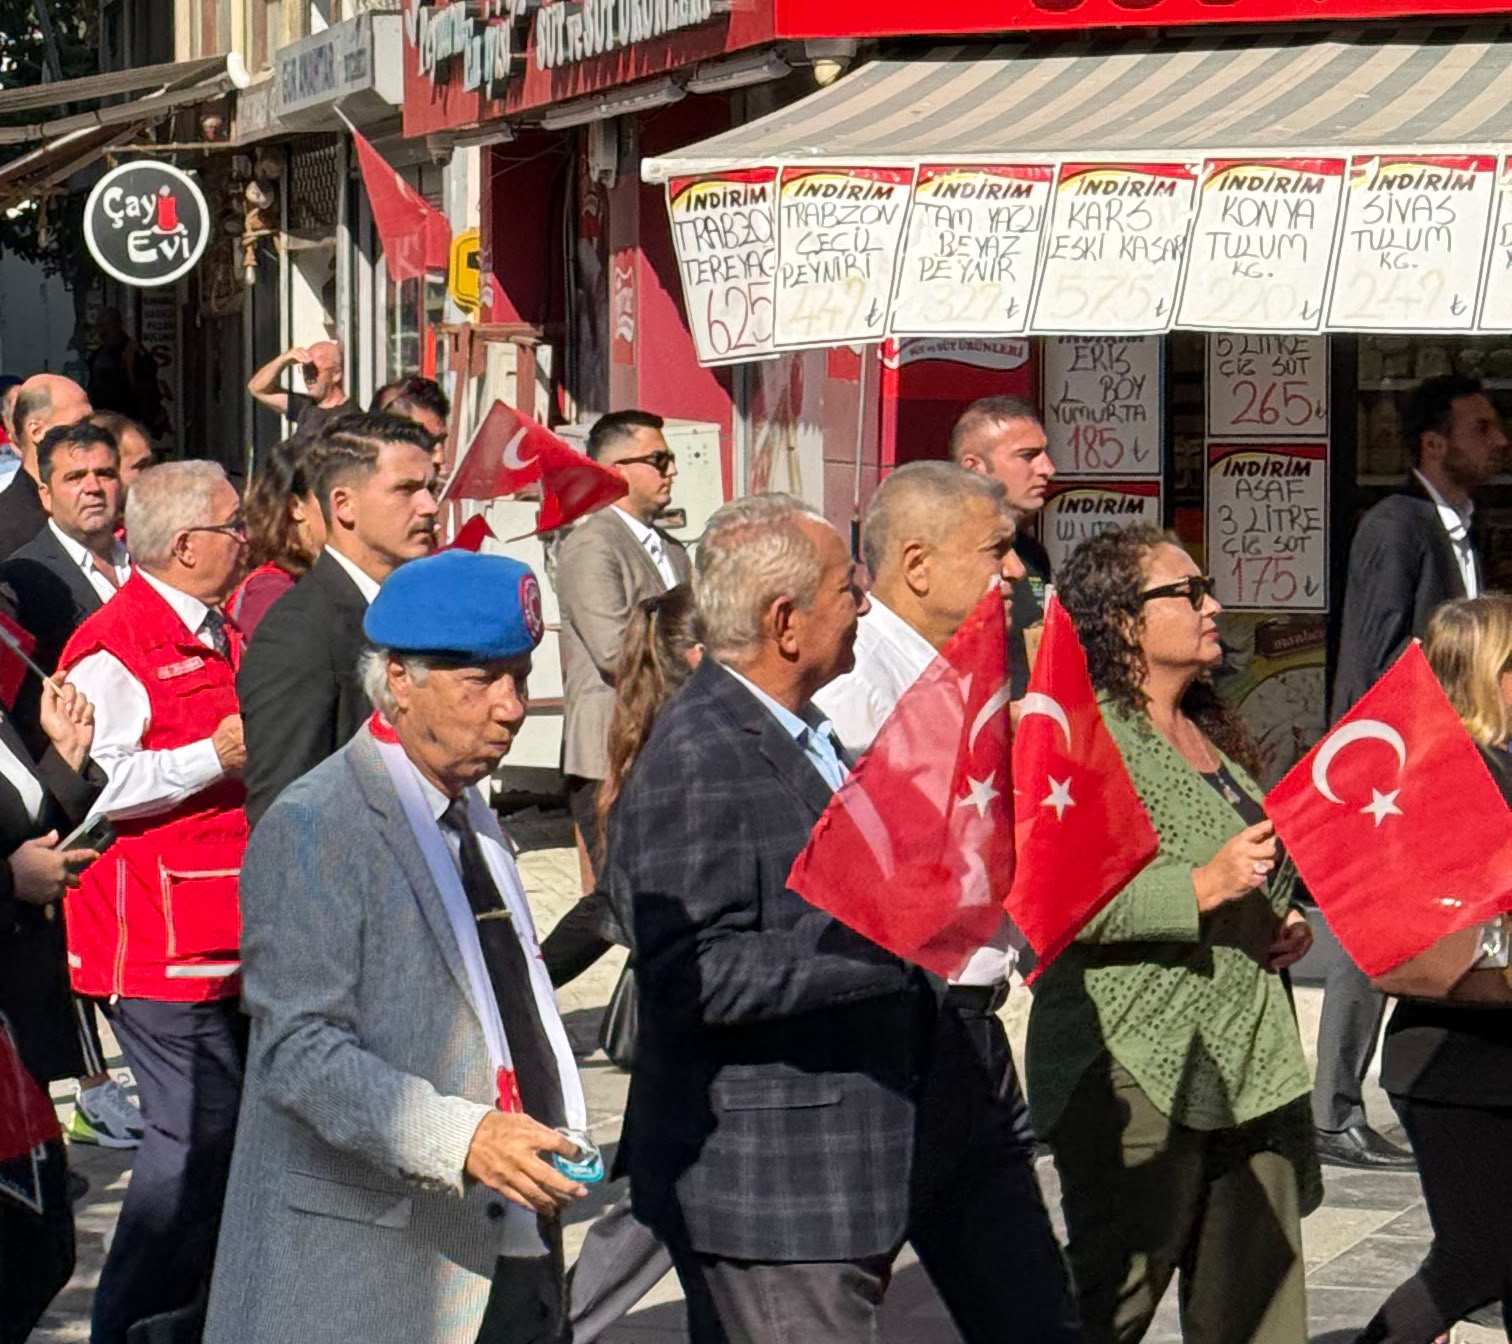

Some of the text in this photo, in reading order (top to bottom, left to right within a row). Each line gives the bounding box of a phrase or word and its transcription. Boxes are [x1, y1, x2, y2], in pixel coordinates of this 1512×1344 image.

[793, 179, 895, 202] İNDİRİM
[931, 177, 1035, 200] İNDİRİM
[1074, 175, 1178, 199] İNDİRİM
[1218, 171, 1326, 194] İNDİRİM
[1368, 168, 1477, 192] İNDİRİM
[101, 186, 157, 229] Çay
[685, 184, 768, 213] İNDİRİM
[1362, 192, 1457, 225] SİVAS
[782, 202, 900, 229] TRABZON
[1067, 197, 1153, 233] KARS
[126, 228, 191, 264] Evi
[936, 230, 1022, 258] BEYAZ
[1204, 231, 1308, 263] TULUM
[1350, 225, 1452, 253] TULUM
[706, 281, 774, 356] 625
[1099, 373, 1147, 404] BOY
[1050, 403, 1147, 425] YUMURTA
[1229, 379, 1312, 427] 265
[1066, 424, 1125, 471] 185
[1221, 457, 1312, 478] İNDİRİM
[1056, 494, 1146, 515] İNDİRİM
[1234, 478, 1305, 503] ASAF
[1217, 504, 1323, 536] 3 LİTRE
[1231, 556, 1297, 603] 175
